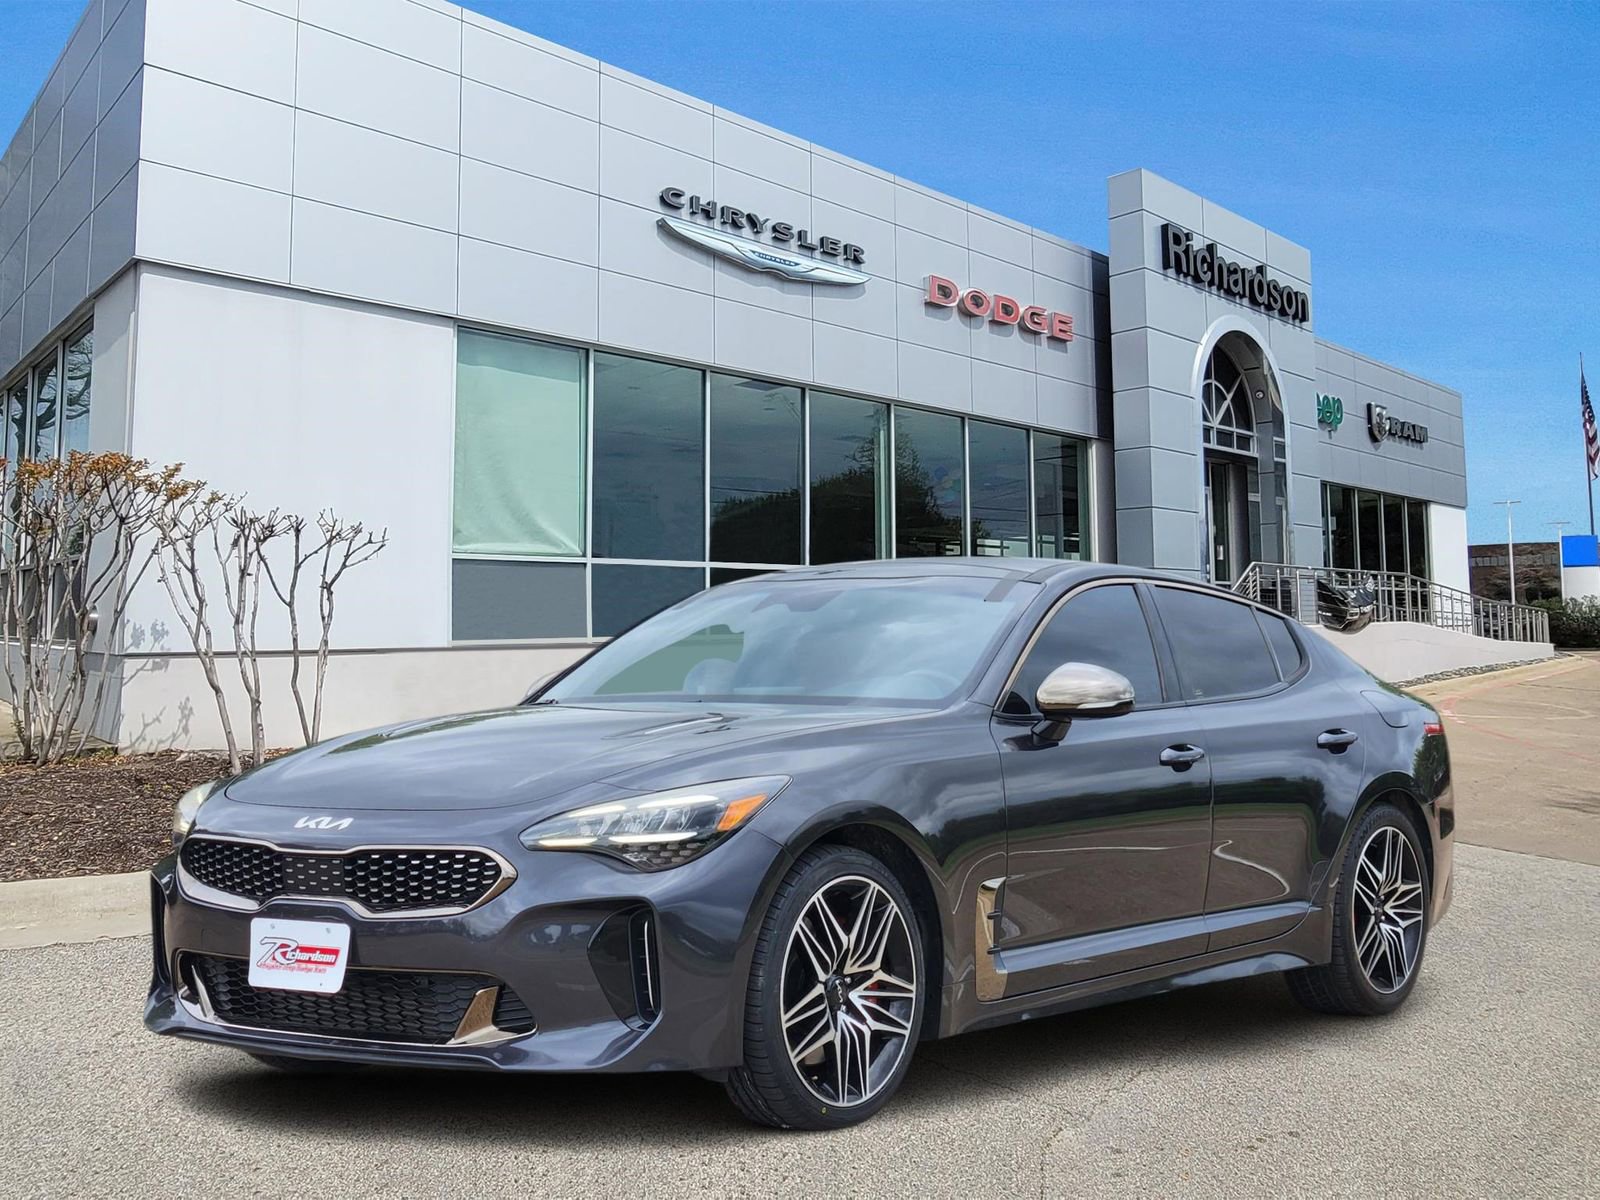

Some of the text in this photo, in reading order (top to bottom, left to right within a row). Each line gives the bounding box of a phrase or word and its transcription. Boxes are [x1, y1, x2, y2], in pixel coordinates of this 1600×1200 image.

[659, 186, 866, 264] CHRYSLER
[1161, 223, 1309, 323] Richardson
[923, 274, 1073, 342] DODGE
[1389, 416, 1428, 443] RAM
[293, 815, 355, 830] KIA
